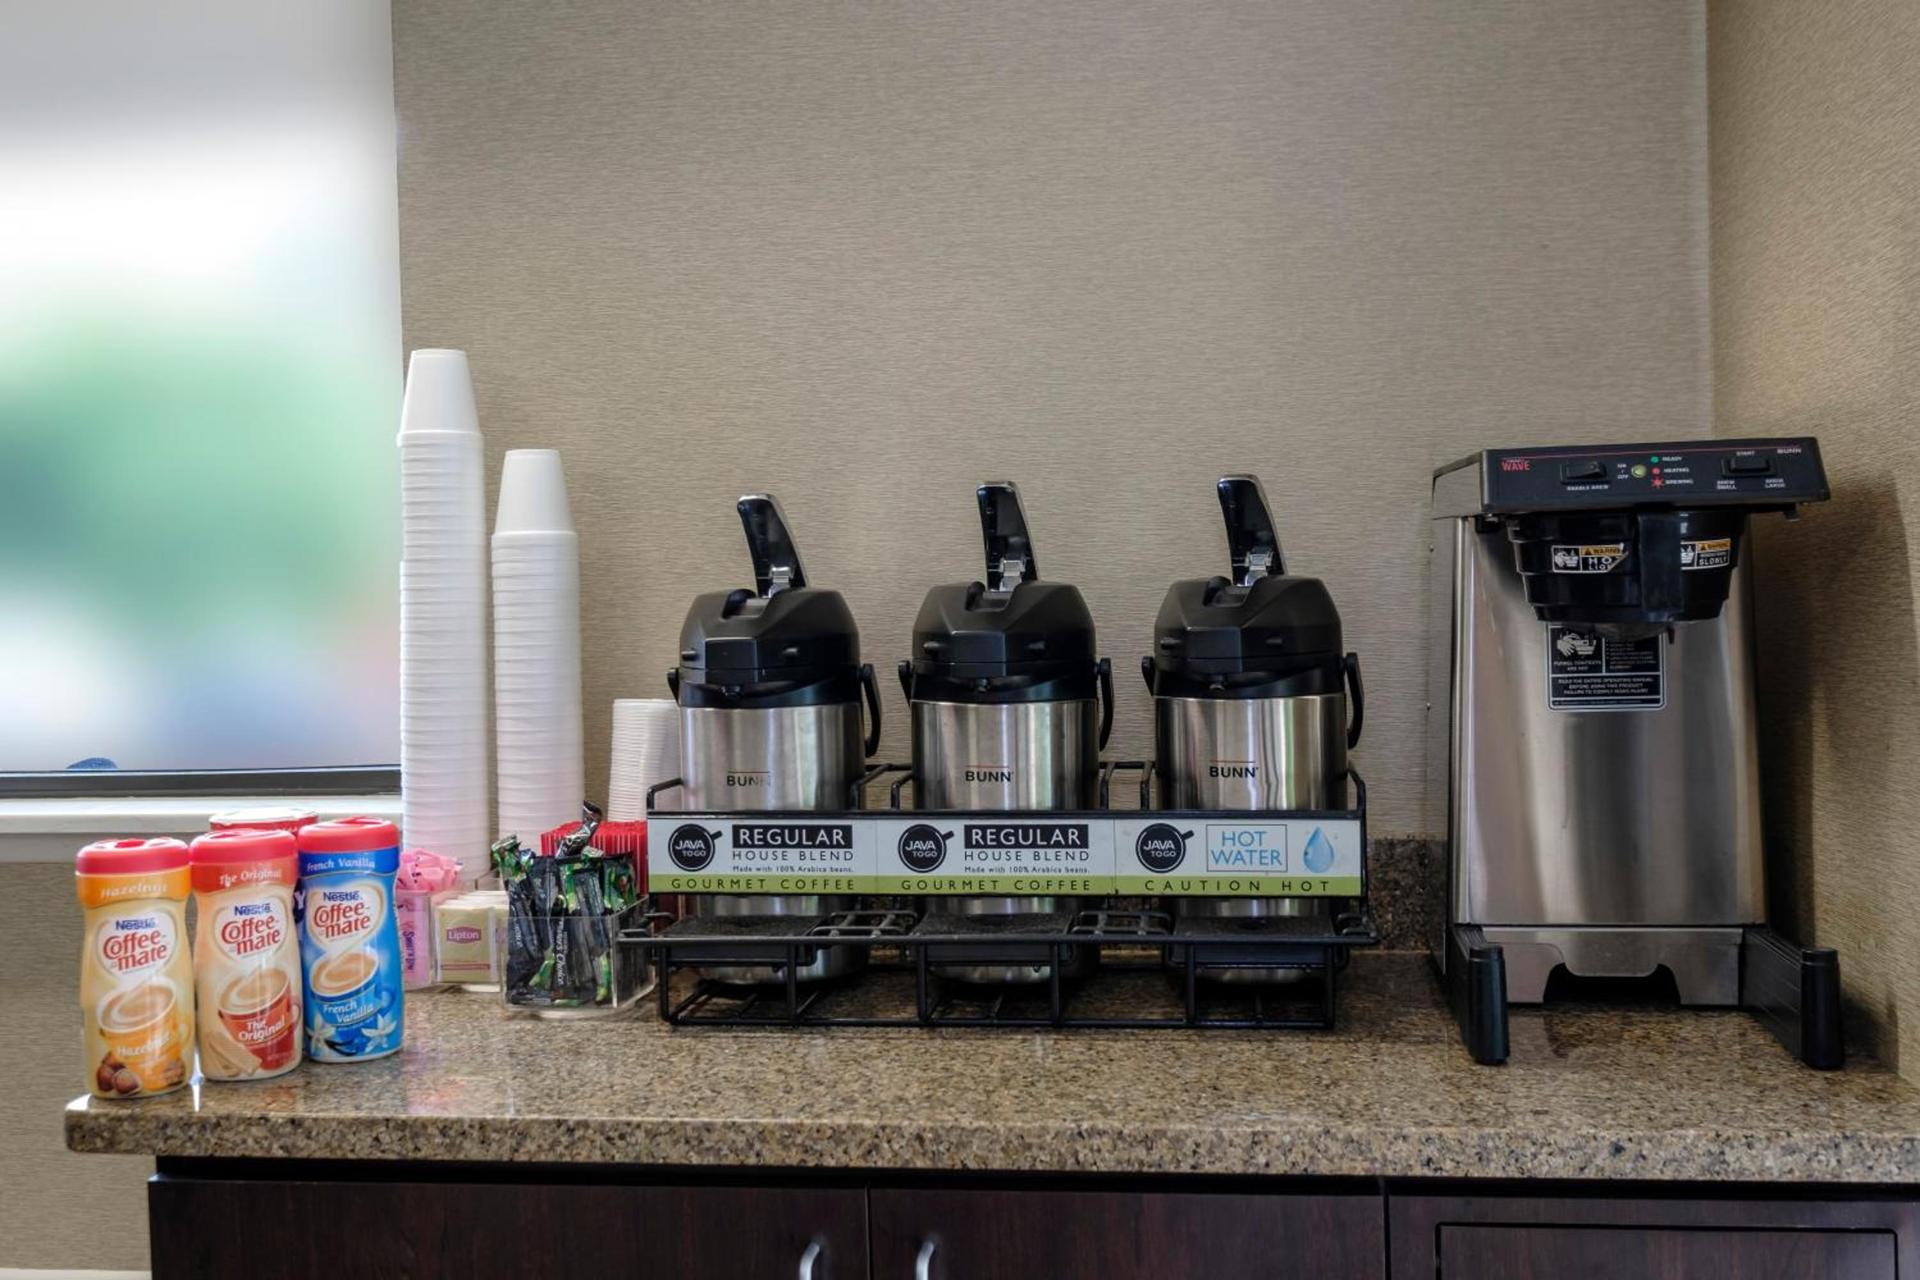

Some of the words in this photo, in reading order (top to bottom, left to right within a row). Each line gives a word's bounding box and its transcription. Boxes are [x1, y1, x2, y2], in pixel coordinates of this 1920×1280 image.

[1502, 461, 1531, 472] WAVE
[1588, 556, 1613, 564] HO
[965, 771, 1012, 782] BUNN
[1209, 766, 1256, 778] BUNN
[726, 775, 770, 787] BUN
[739, 828, 846, 845] REGULAR
[971, 828, 1081, 845] REGULAR
[1221, 830, 1267, 846] HOT
[675, 839, 706, 850] JAVA
[905, 840, 936, 851] JAVA
[1143, 840, 1175, 851] JAVA
[732, 850, 789, 861] HOUSE
[799, 850, 855, 861] BLEND
[964, 850, 1022, 861] HOUSE
[1033, 850, 1090, 861] BLEND
[1211, 850, 1283, 867] WATER
[306, 859, 334, 872] French
[338, 856, 376, 868] Vanilla
[732, 865, 752, 873] Made
[755, 865, 773, 873] with
[776, 865, 795, 873] 100%
[797, 865, 828, 873] Arabica
[964, 866, 985, 874] Made
[992, 866, 1006, 874] with
[1008, 866, 1030, 874] 100%
[1032, 866, 1062, 874] Arabica
[240, 868, 282, 881] Original
[671, 878, 766, 890] GOURMET
[780, 879, 855, 890] COFFEE
[901, 879, 1000, 891] GOURMET
[1014, 879, 1091, 891] COFFEE
[1144, 879, 1260, 892] CAUTION
[1281, 879, 1330, 892] HOT
[325, 915, 371, 939] mate
[448, 929, 480, 940] Lipton
[236, 929, 280, 956] mate
[118, 944, 168, 971] mate
[322, 999, 357, 1014] French
[336, 1004, 377, 1023] Vanilla
[238, 1016, 286, 1041] Original
[247, 1019, 267, 1032] The
